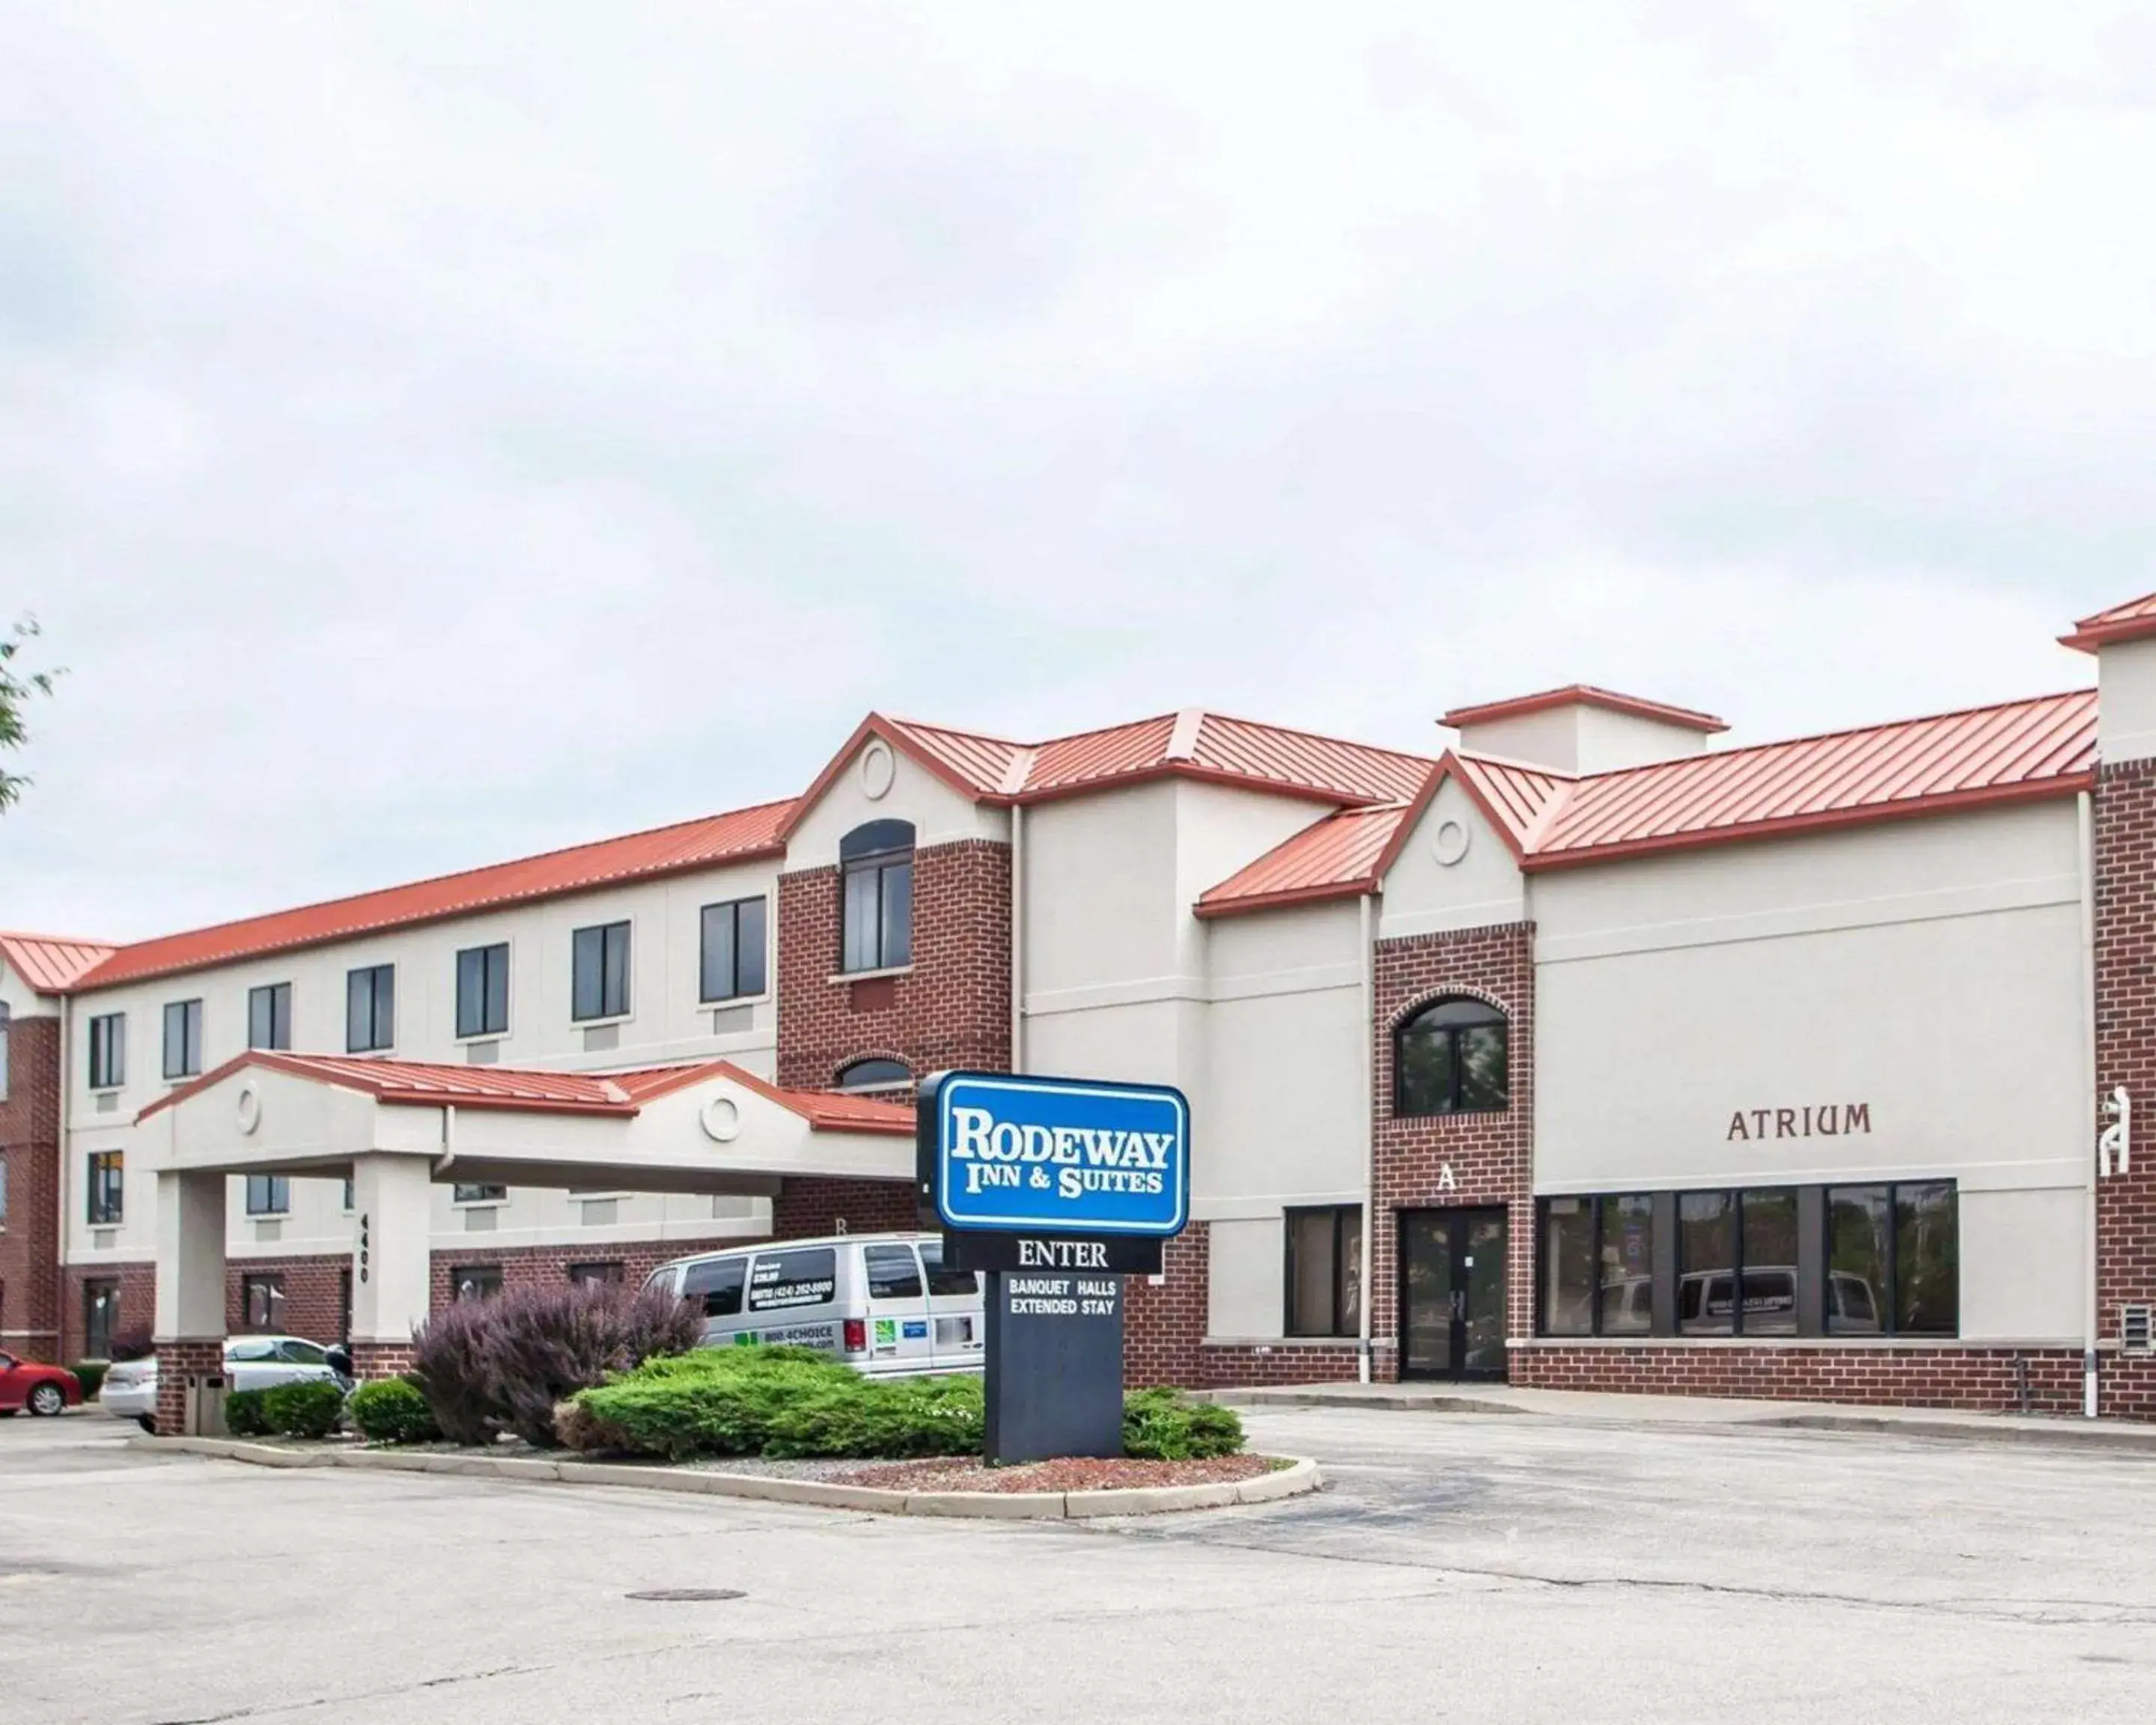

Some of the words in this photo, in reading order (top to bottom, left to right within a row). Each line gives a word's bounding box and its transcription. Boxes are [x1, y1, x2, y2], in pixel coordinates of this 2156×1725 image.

[1727, 1103, 1872, 1140] ATRIUM
[951, 1107, 1174, 1169] RODEWAY
[966, 1163, 1021, 1193] INN
[1029, 1166, 1050, 1189] &
[1059, 1168, 1163, 1199] SUITES
[1436, 1163, 1457, 1190] A
[1017, 1239, 1109, 1268] ENTER
[1009, 1279, 1071, 1295] BANQUET
[1077, 1280, 1116, 1296] HALLS
[1011, 1297, 1077, 1314] EXTENDED
[1080, 1300, 1115, 1315] STAY
